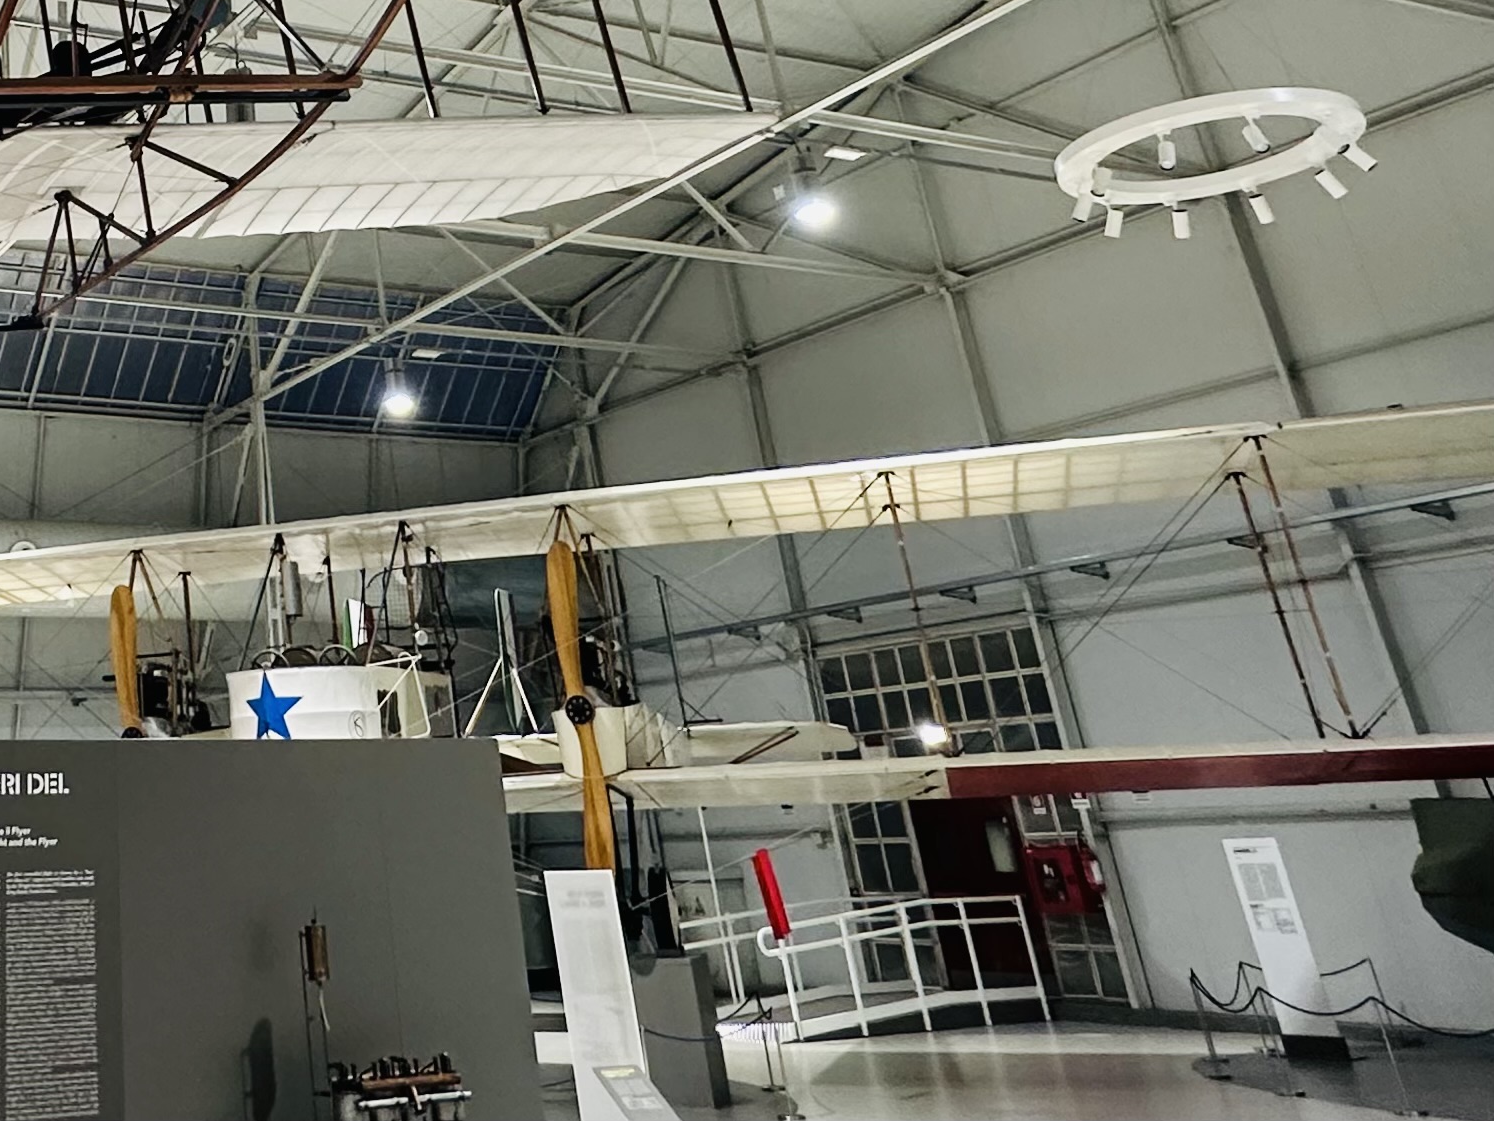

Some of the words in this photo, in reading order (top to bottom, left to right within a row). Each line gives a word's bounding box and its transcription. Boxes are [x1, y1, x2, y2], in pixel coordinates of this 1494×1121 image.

[27, 772, 70, 795] DEL
[11, 825, 31, 837] Flyer
[8, 837, 23, 847] and
[24, 837, 37, 846] the
[38, 836, 58, 848] Flyer
